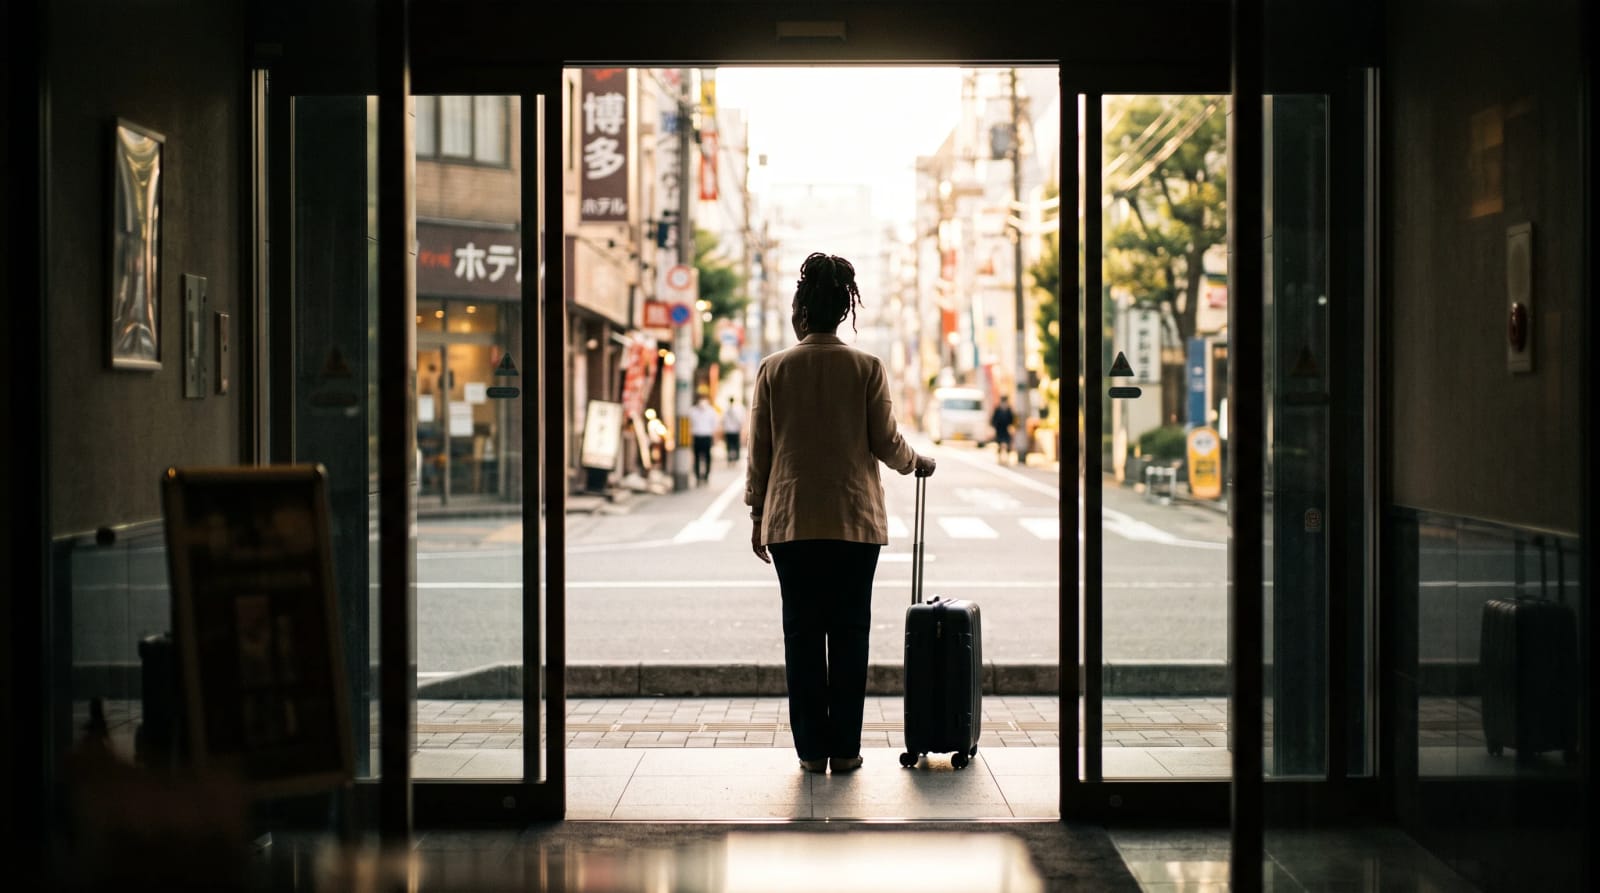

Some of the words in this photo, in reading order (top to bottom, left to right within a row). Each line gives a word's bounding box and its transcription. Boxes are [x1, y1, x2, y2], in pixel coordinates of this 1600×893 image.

[583, 92, 626, 180] 博多
[582, 197, 626, 215] ホテル
